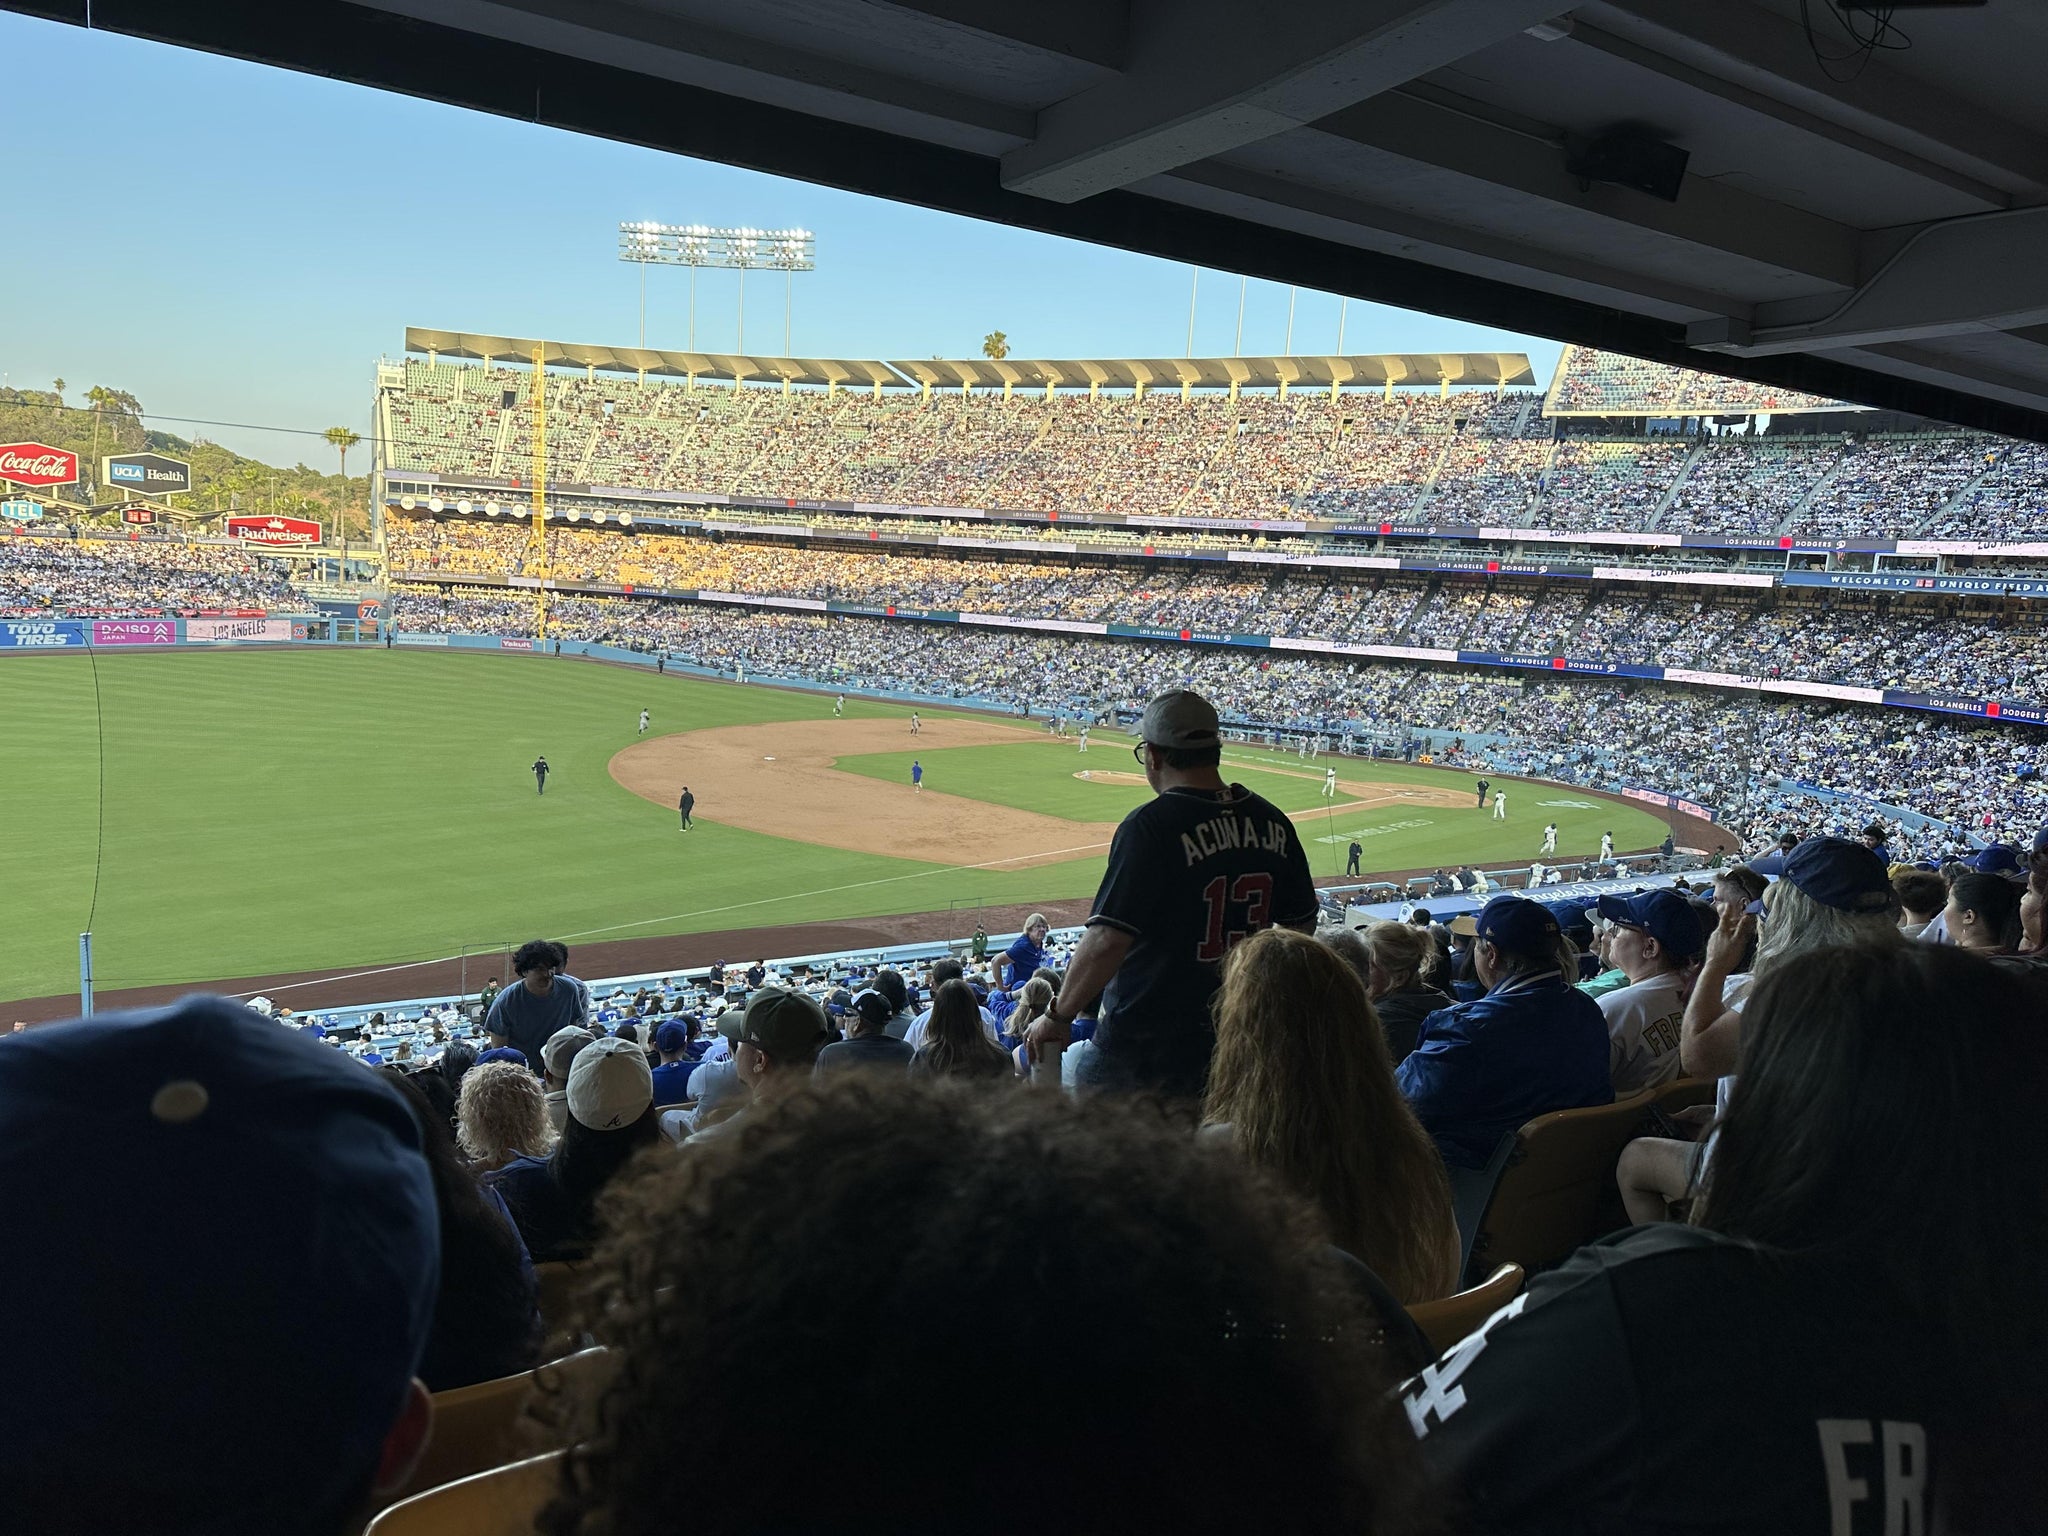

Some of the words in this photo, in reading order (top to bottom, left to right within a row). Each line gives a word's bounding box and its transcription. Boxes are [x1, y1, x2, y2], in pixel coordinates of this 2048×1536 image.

[0, 451, 70, 477] Coca-Cola
[114, 468, 142, 478] UCLA
[147, 469, 185, 482] Health
[6, 503, 38, 518] TEL
[237, 526, 313, 542] Budweiser
[1795, 540, 1832, 548] DODGERS
[1831, 576, 1889, 585] WELCOME
[1895, 578, 1911, 586] TO
[1939, 580, 1989, 590] UNIQLO
[362, 605, 379, 619] 76
[7, 623, 56, 635] TOYO
[101, 624, 150, 634] DAISO
[231, 620, 266, 638] ANGELES
[15, 633, 68, 645] TIRES
[503, 640, 532, 648] Yakult
[1516, 658, 1549, 666] ANGELES
[1568, 662, 1603, 670] DODGERS
[1929, 699, 1944, 707] LOS
[1946, 701, 1982, 712] ANGELES
[2002, 708, 2040, 720] DODGERS
[1181, 809, 1260, 867] ACUÑA
[1197, 872, 1273, 962] 13
